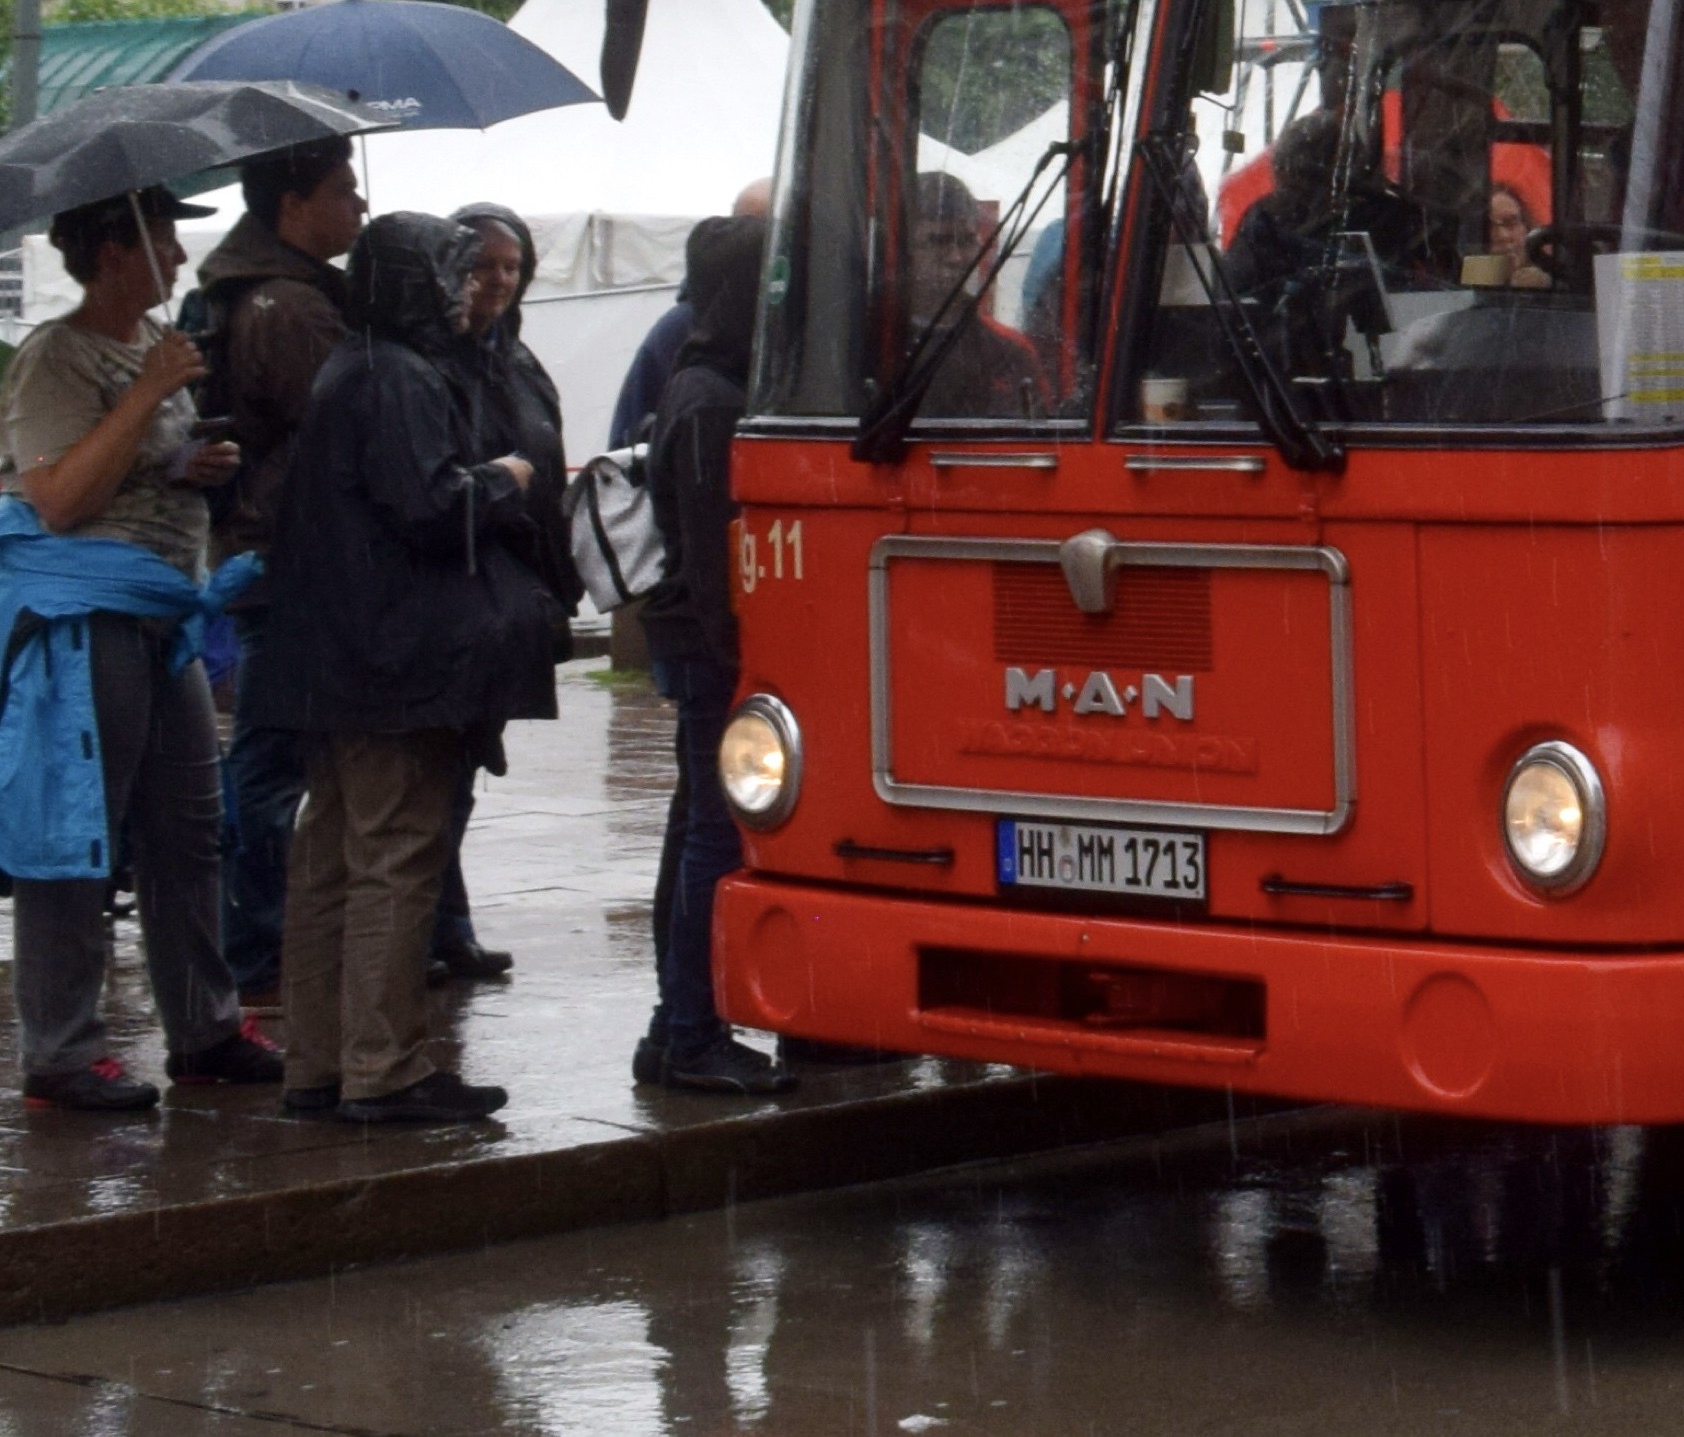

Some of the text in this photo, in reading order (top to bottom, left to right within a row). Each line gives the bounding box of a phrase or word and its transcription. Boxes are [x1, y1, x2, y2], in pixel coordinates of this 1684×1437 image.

[1018, 829, 1055, 879] HH
[1077, 833, 1116, 883] MM
[1124, 837, 1200, 890] 1713
